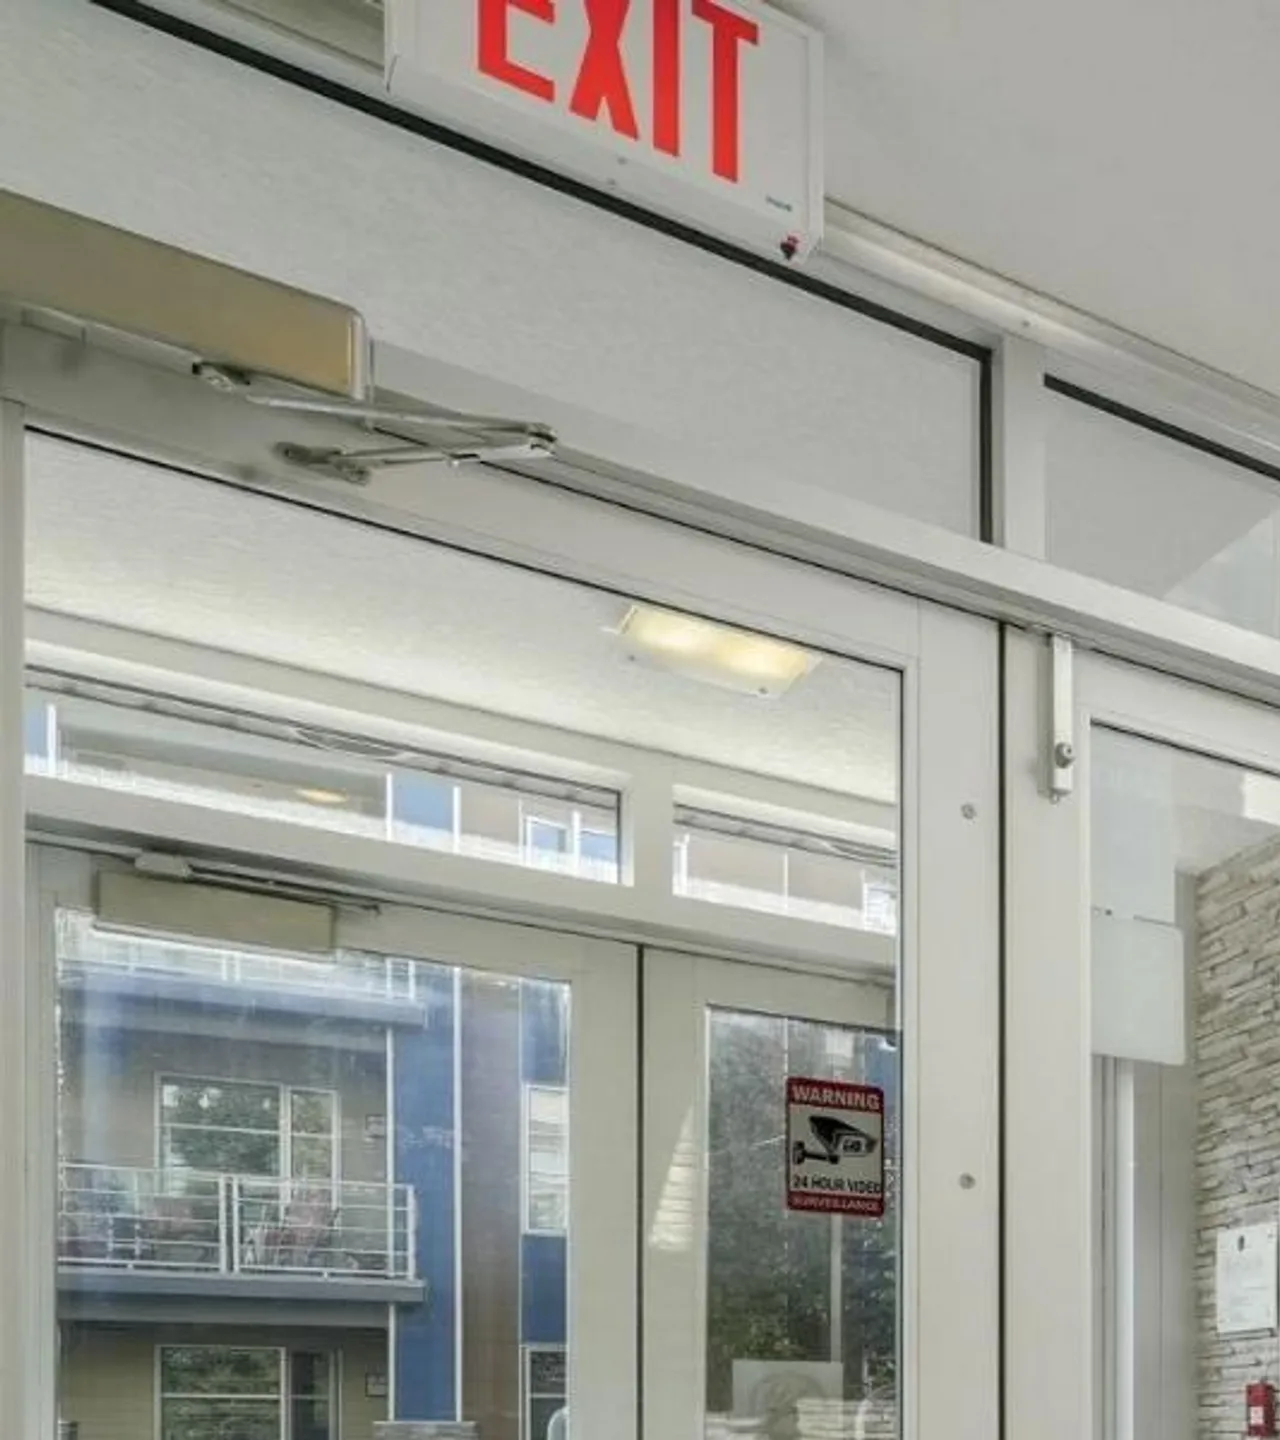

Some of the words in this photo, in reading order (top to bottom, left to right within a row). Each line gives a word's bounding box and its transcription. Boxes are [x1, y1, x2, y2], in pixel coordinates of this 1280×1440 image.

[477, 0, 759, 183] EXIT
[791, 1084, 880, 1110] WARNING
[793, 1175, 808, 1188] 24
[811, 1176, 843, 1190] HOUR
[848, 1179, 881, 1193] VIDEO
